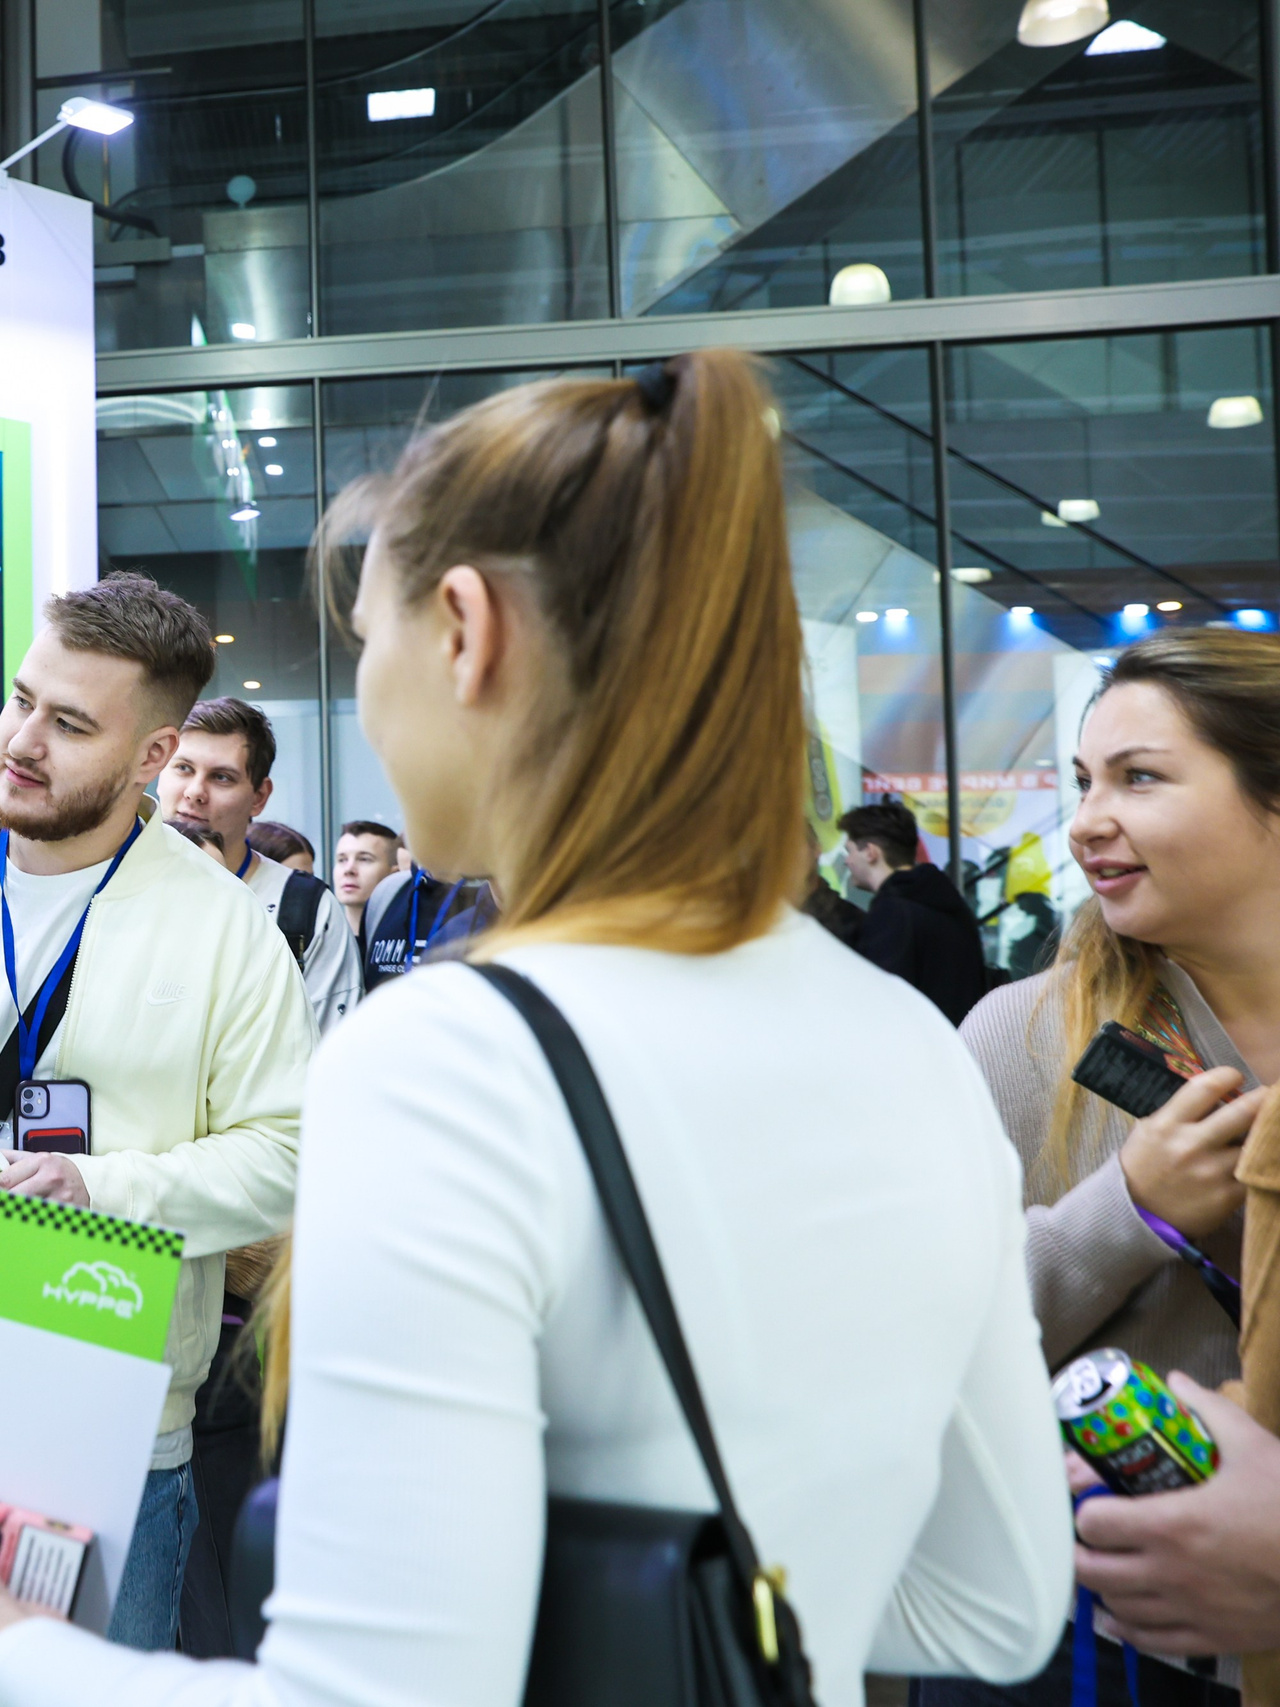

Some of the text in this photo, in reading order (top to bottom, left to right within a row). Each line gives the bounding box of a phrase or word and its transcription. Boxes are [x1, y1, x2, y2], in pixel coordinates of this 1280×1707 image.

[370, 939, 407, 964] TOMM
[156, 980, 187, 997] NIKE
[42, 1280, 134, 1320] HYPPE
